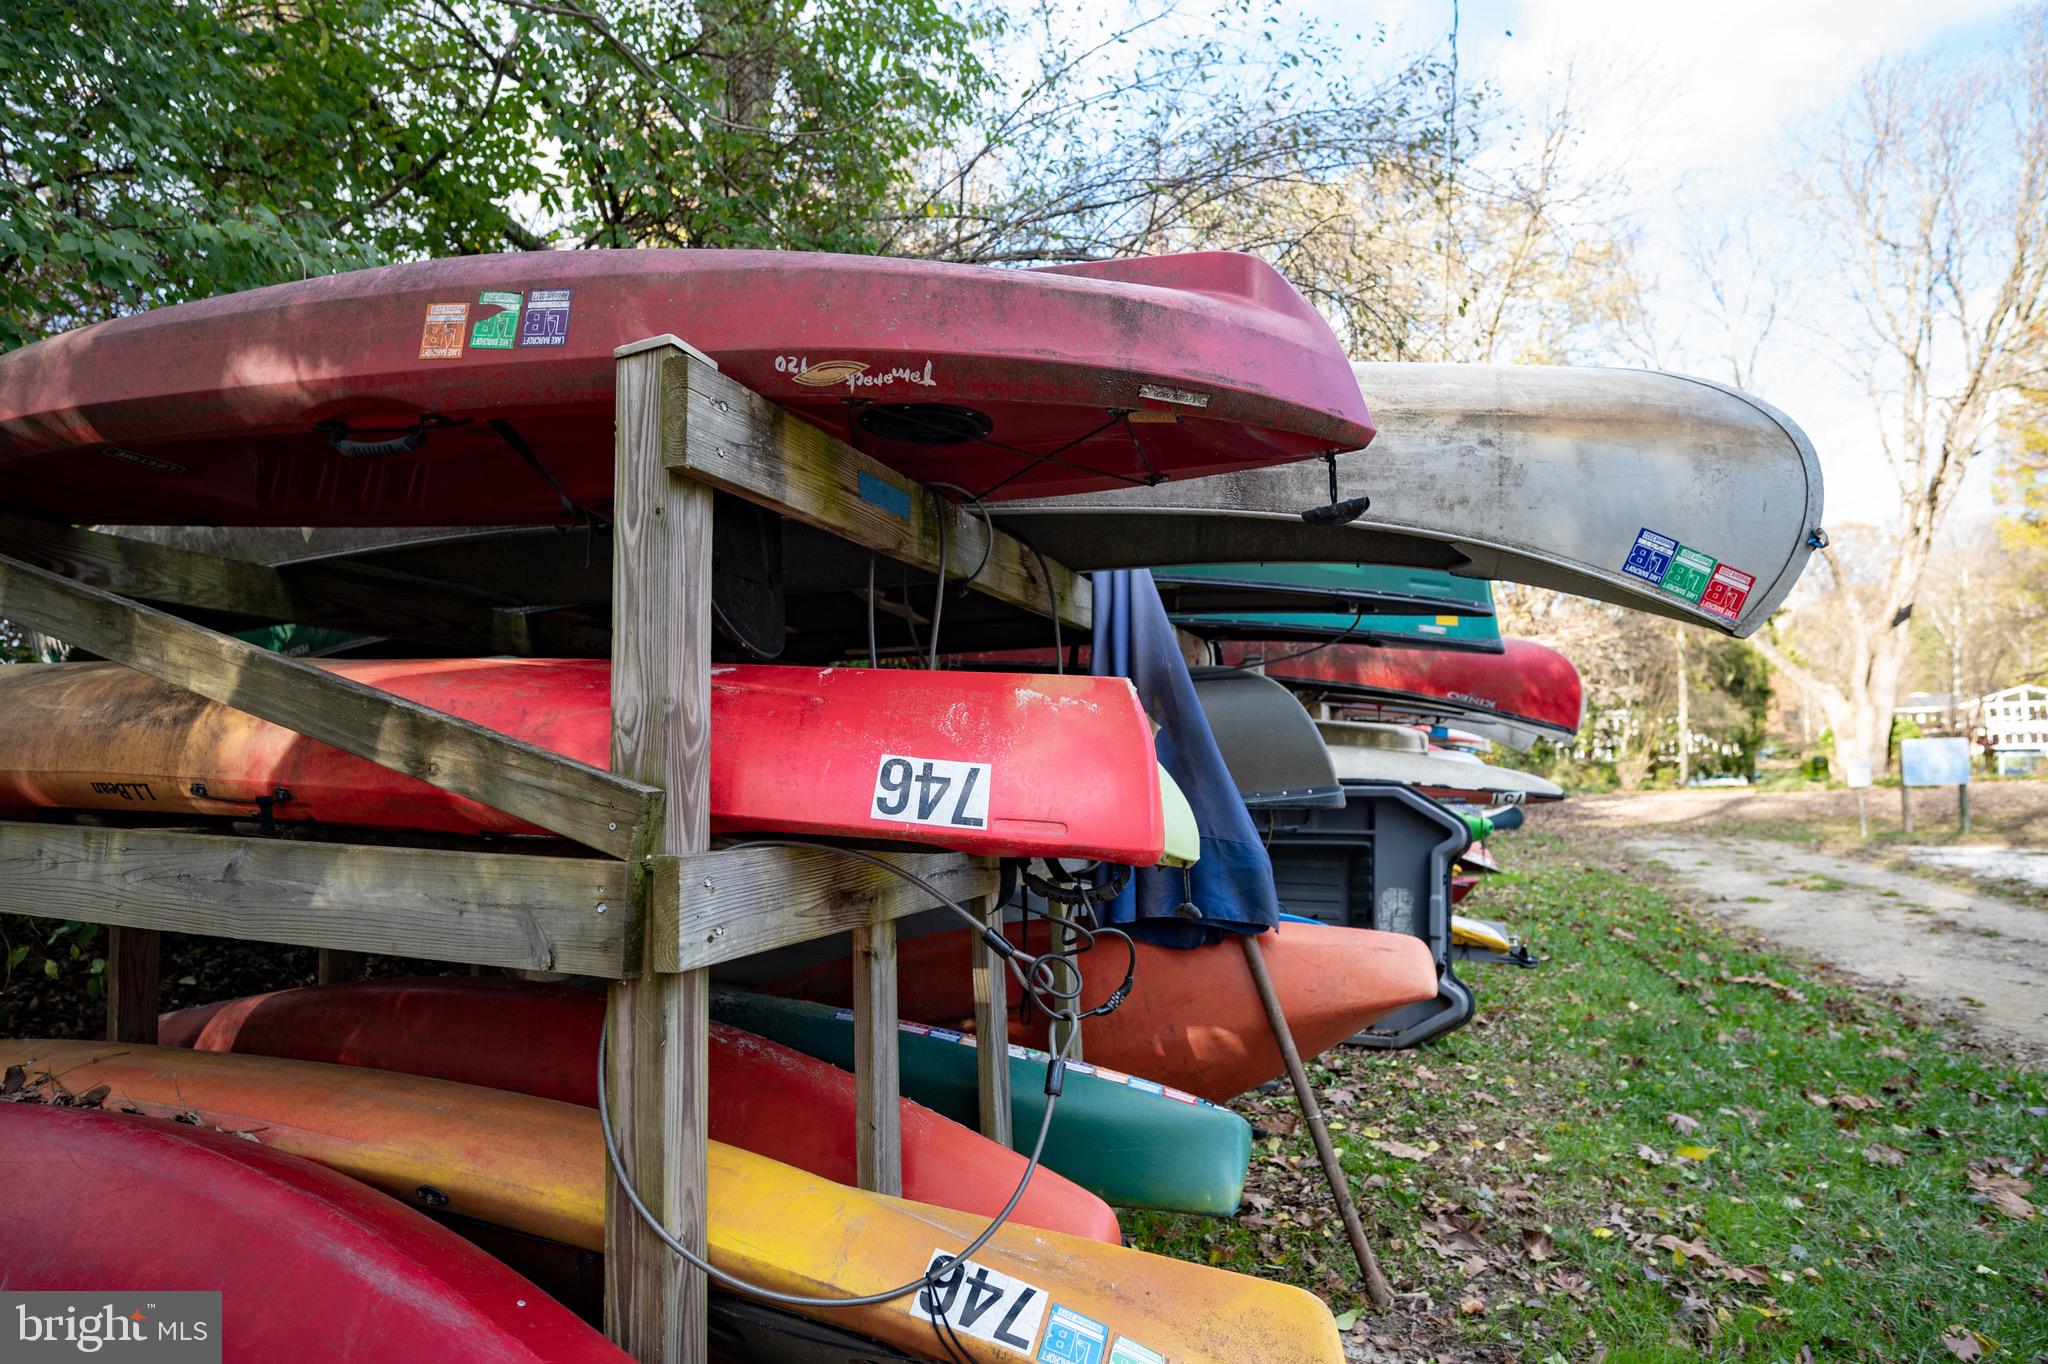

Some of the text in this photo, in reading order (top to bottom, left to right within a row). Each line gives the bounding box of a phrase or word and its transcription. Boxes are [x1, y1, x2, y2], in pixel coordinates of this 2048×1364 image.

[472, 337, 513, 347] LAKE BARCROFT
[522, 336, 565, 345] LAKE BARCROFT
[775, 355, 937, 394] Tamarack 120
[1624, 564, 1661, 583] LAKE BARCROFT
[1662, 581, 1699, 601] LAKE BARCROFT
[1700, 600, 1737, 618] LAKE BARCROFT
[877, 758, 983, 827] 746
[919, 1254, 1037, 1350] 746
